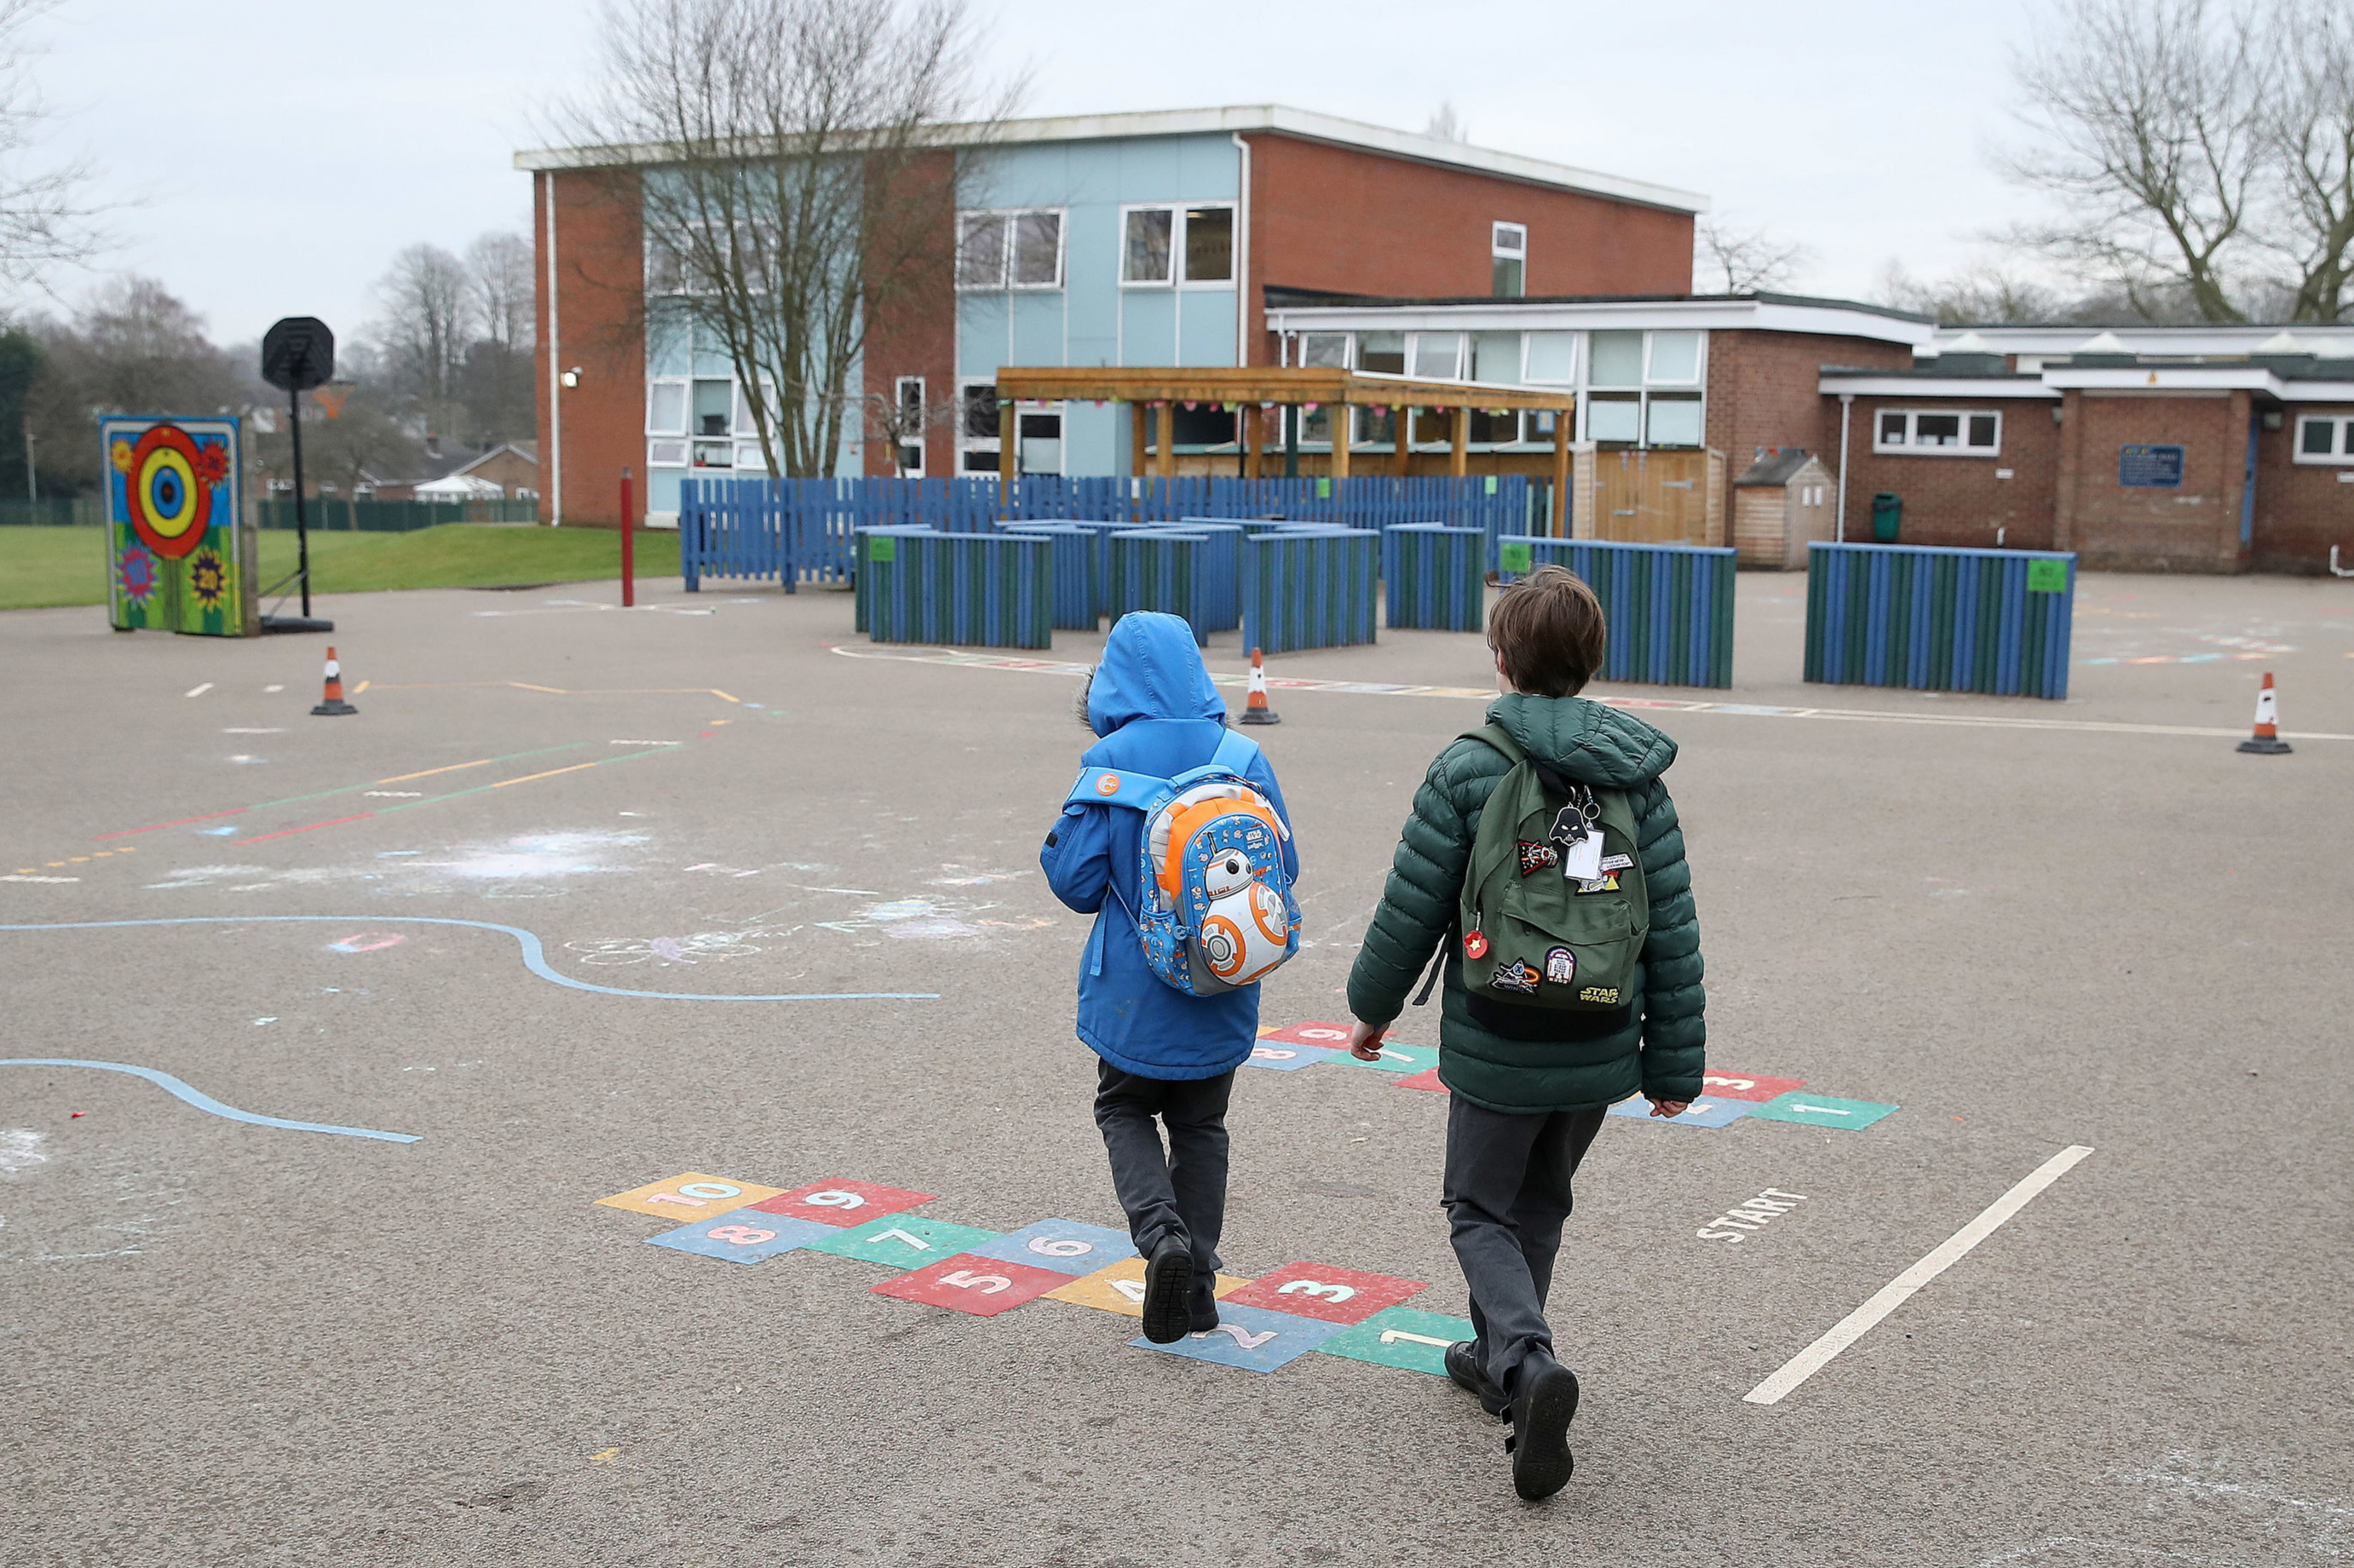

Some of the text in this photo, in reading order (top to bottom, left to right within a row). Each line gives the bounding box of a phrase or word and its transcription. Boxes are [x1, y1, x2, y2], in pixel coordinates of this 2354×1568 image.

[198, 568, 218, 589] 20
[1580, 987, 1619, 997] STAR
[1580, 993, 1618, 1003] WARS
[1298, 1028, 1348, 1041] 9
[1252, 1048, 1297, 1060] 8
[1704, 1076, 1755, 1091] 3
[1793, 1103, 1851, 1116] 1
[647, 1182, 741, 1208] 10
[805, 1190, 865, 1210] 9
[1696, 1187, 1808, 1243] START
[706, 1225, 777, 1245] 8
[866, 1229, 931, 1250] 7
[1027, 1237, 1094, 1256] 6
[939, 1271, 1012, 1295] 5
[1278, 1280, 1355, 1303] 3
[1191, 1324, 1279, 1349] 2
[1379, 1330, 1453, 1348] 1
